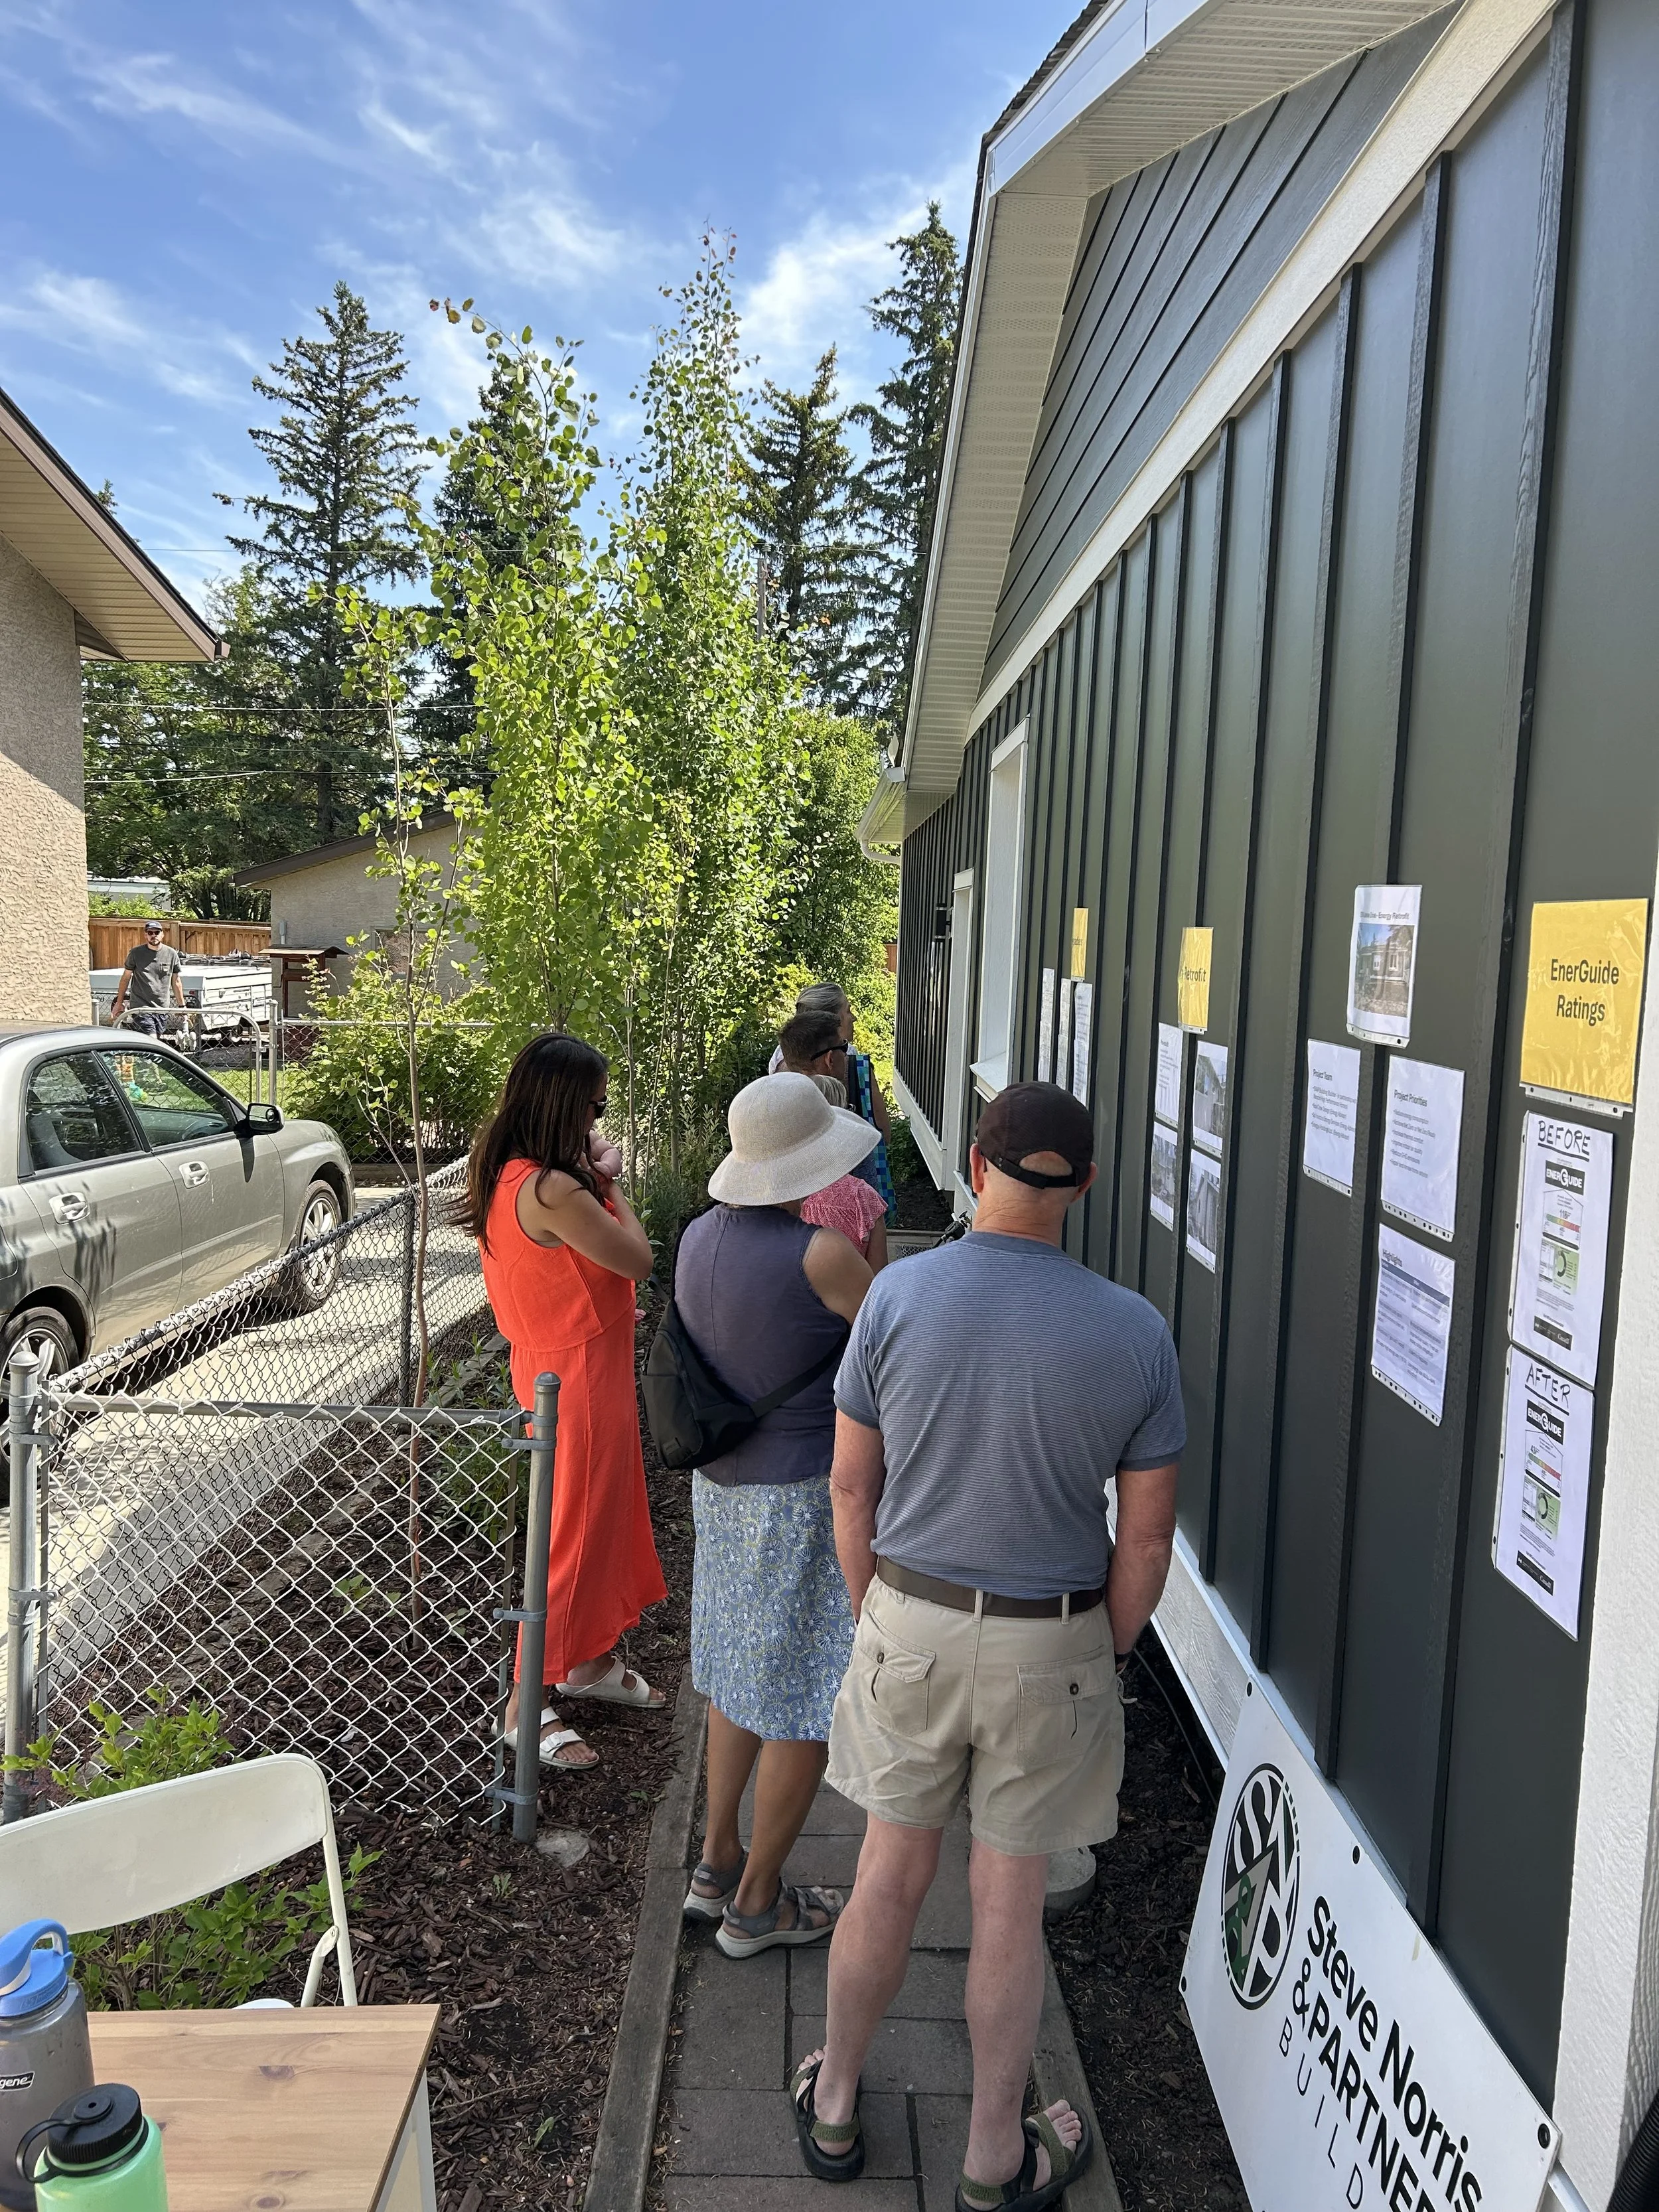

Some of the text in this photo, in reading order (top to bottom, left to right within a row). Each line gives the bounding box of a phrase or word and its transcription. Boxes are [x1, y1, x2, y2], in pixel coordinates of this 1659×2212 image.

[1550, 958, 1620, 985] EnerGuide
[1556, 995, 1606, 1027] Ratings
[1538, 1120, 1591, 1156] BEFORE
[1526, 1363, 1571, 1408] AFTER
[1307, 1895, 1482, 2212] Steve Norris
[1279, 2016, 1364, 2210] BUILD
[1308, 1991, 1437, 2212] PARTNE
